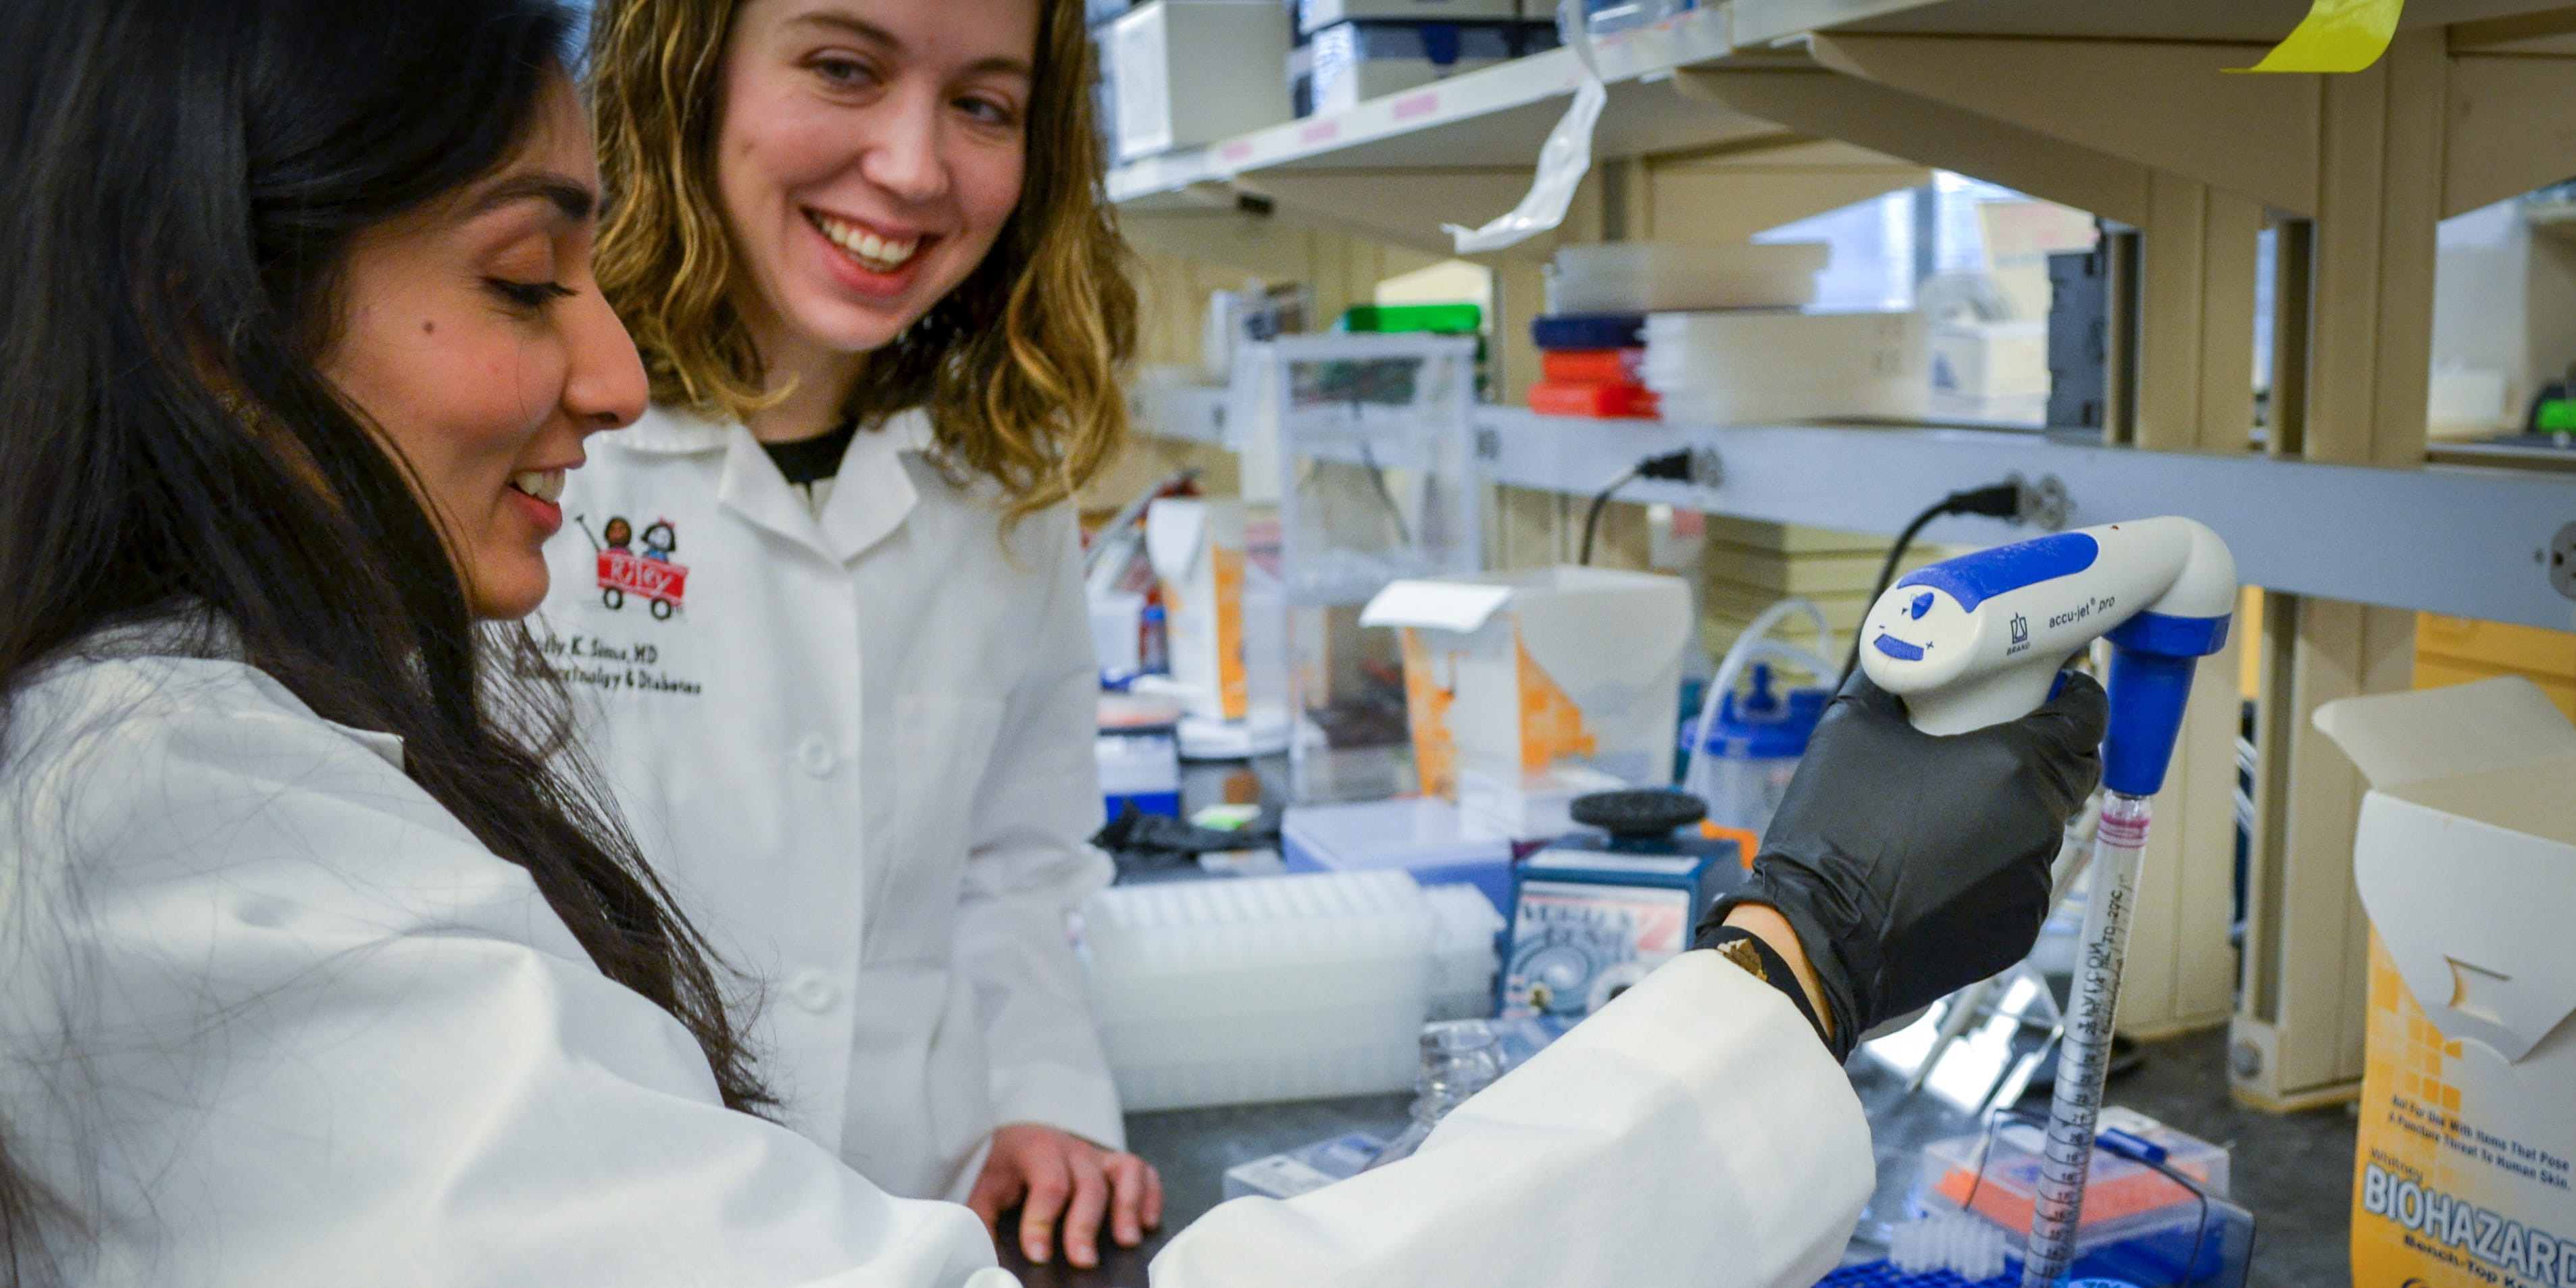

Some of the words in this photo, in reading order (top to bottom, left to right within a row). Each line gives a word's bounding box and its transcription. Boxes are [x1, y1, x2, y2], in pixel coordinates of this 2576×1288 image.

[610, 555, 674, 595] Riley
[2098, 596, 2115, 614] pro
[2006, 642, 2031, 656] BRAND
[2398, 1114, 2442, 1143] Puncture
[2444, 1133, 2479, 1158] Threat
[2481, 1148, 2494, 1164] To
[2496, 1154, 2537, 1179] Human
[2540, 1168, 2572, 1192] Skin.
[2408, 1102, 2425, 1118] For
[2428, 1110, 2446, 1127] Use
[2450, 1118, 2474, 1138] With
[2476, 1129, 2508, 1152] Items
[2511, 1139, 2537, 1161] That
[2540, 1150, 2570, 1172] Pose
